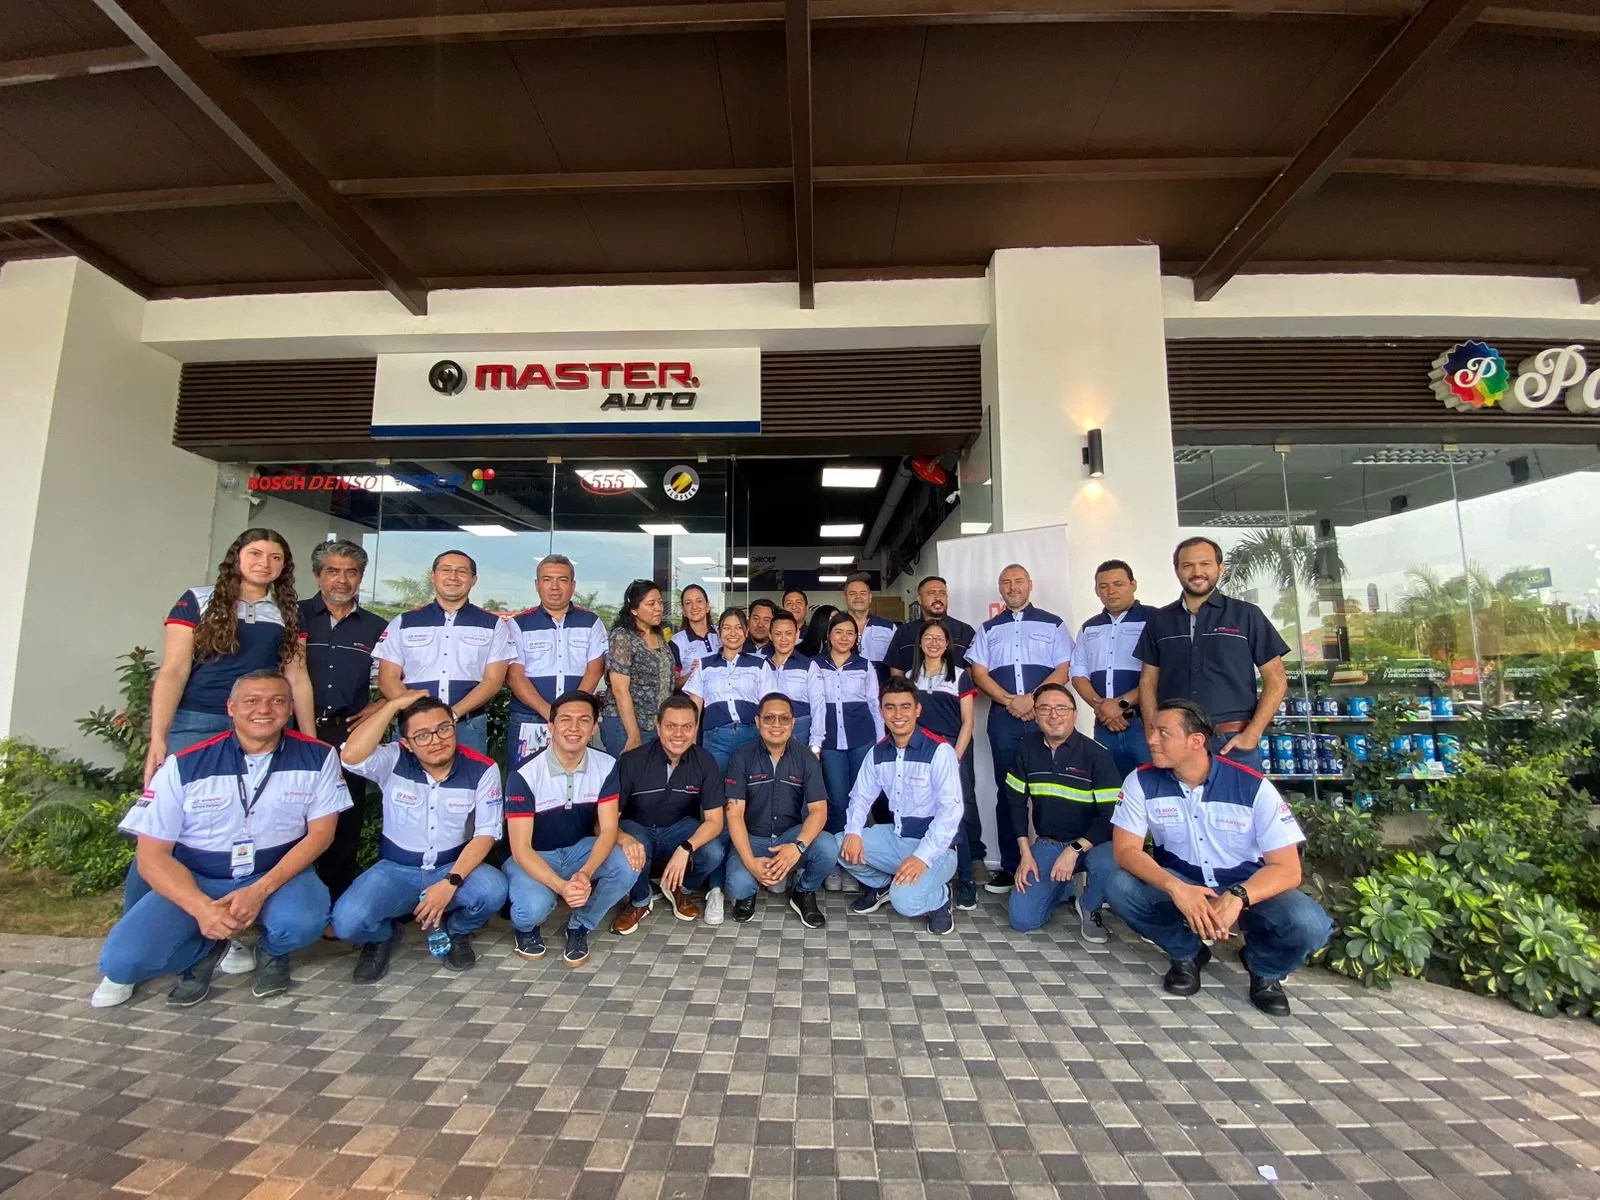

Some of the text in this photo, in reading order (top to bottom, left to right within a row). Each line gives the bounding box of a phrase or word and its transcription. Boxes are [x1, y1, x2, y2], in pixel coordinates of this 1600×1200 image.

[600, 392, 698, 411] AUTO
[247, 475, 306, 490] BOSCH
[308, 475, 378, 490] DENSO
[591, 474, 626, 491] 555
